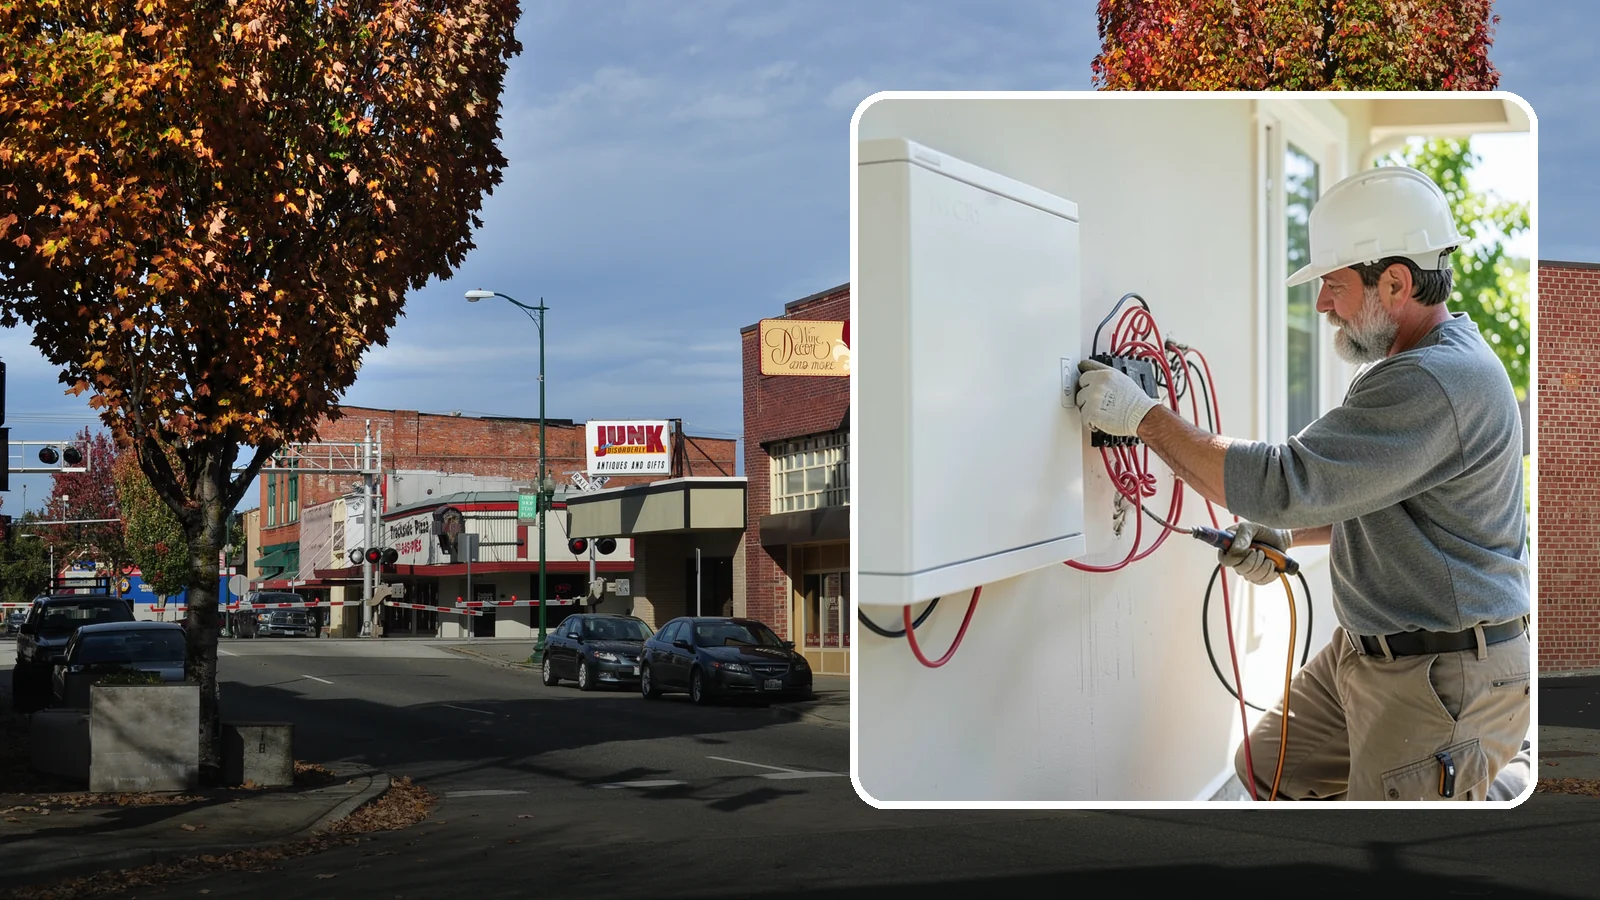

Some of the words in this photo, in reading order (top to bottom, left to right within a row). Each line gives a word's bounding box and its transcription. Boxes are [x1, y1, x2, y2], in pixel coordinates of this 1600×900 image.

[595, 425, 665, 457] JUNK
[597, 461, 628, 469] ANTIQUES
[631, 461, 643, 469] AND
[647, 461, 665, 469] GIFTS
